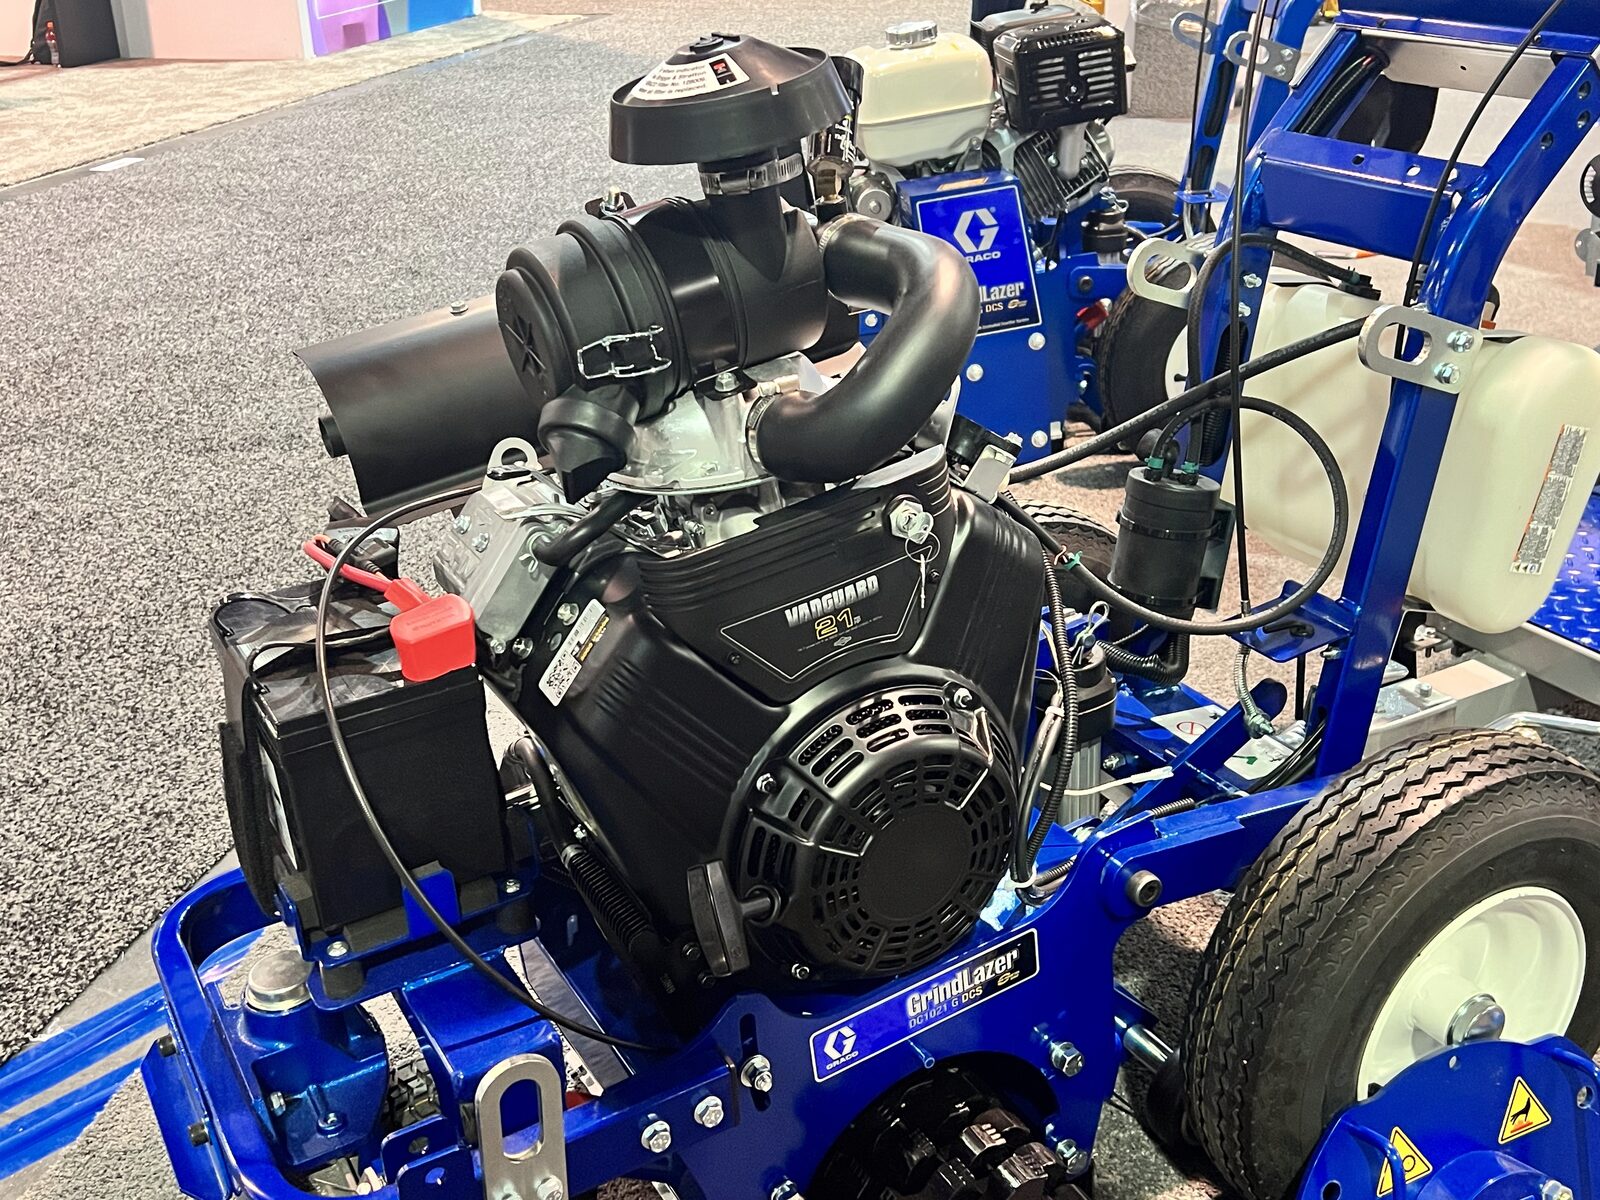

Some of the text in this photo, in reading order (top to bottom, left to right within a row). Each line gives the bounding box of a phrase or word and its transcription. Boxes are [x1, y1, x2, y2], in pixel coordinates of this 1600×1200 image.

[965, 251, 1001, 263] RACO
[979, 281, 1025, 303] Lazer
[784, 574, 880, 628] VANGUARD
[814, 607, 854, 640] 21
[906, 948, 1018, 1018] GrindLazer
[908, 985, 984, 1030] DC1021 G DCS
